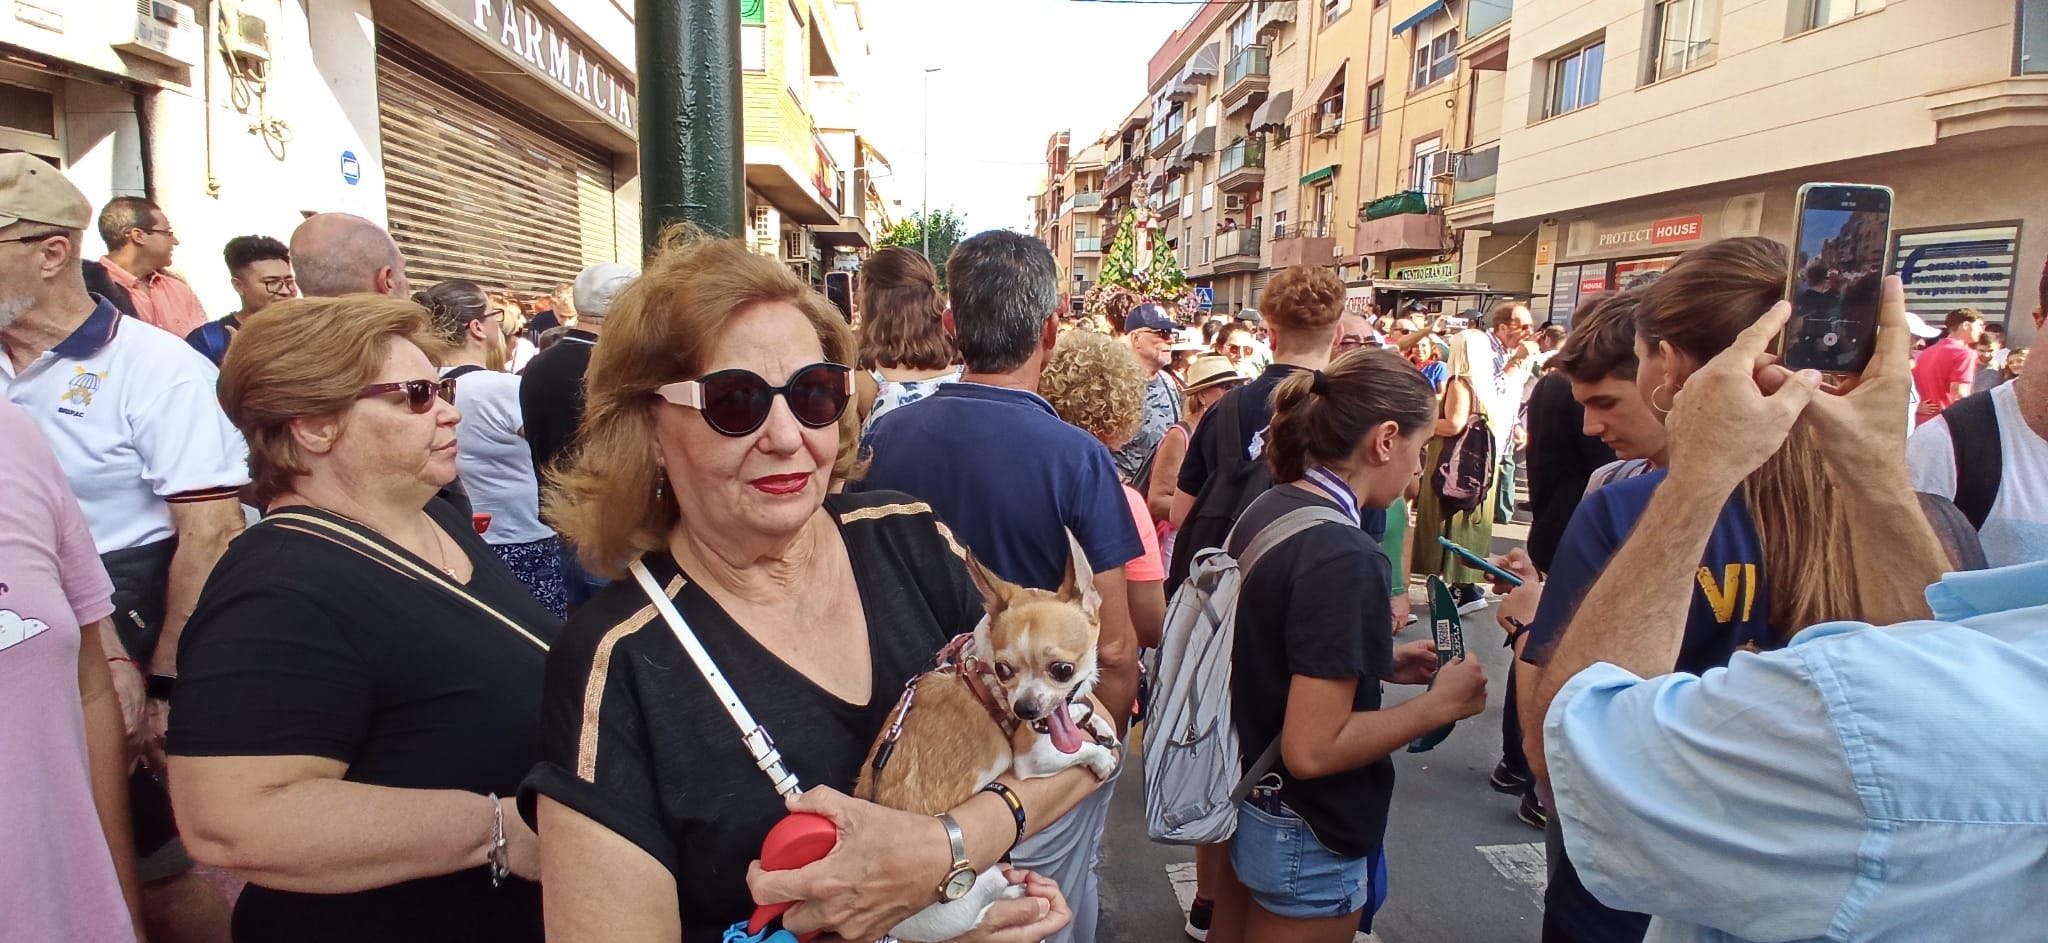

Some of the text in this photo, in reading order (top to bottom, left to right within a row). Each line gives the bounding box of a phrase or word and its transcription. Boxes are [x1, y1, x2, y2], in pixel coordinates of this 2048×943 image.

[1600, 222, 1698, 246] PROTECT HOUSE
[1583, 281, 1603, 290] HOUSE
